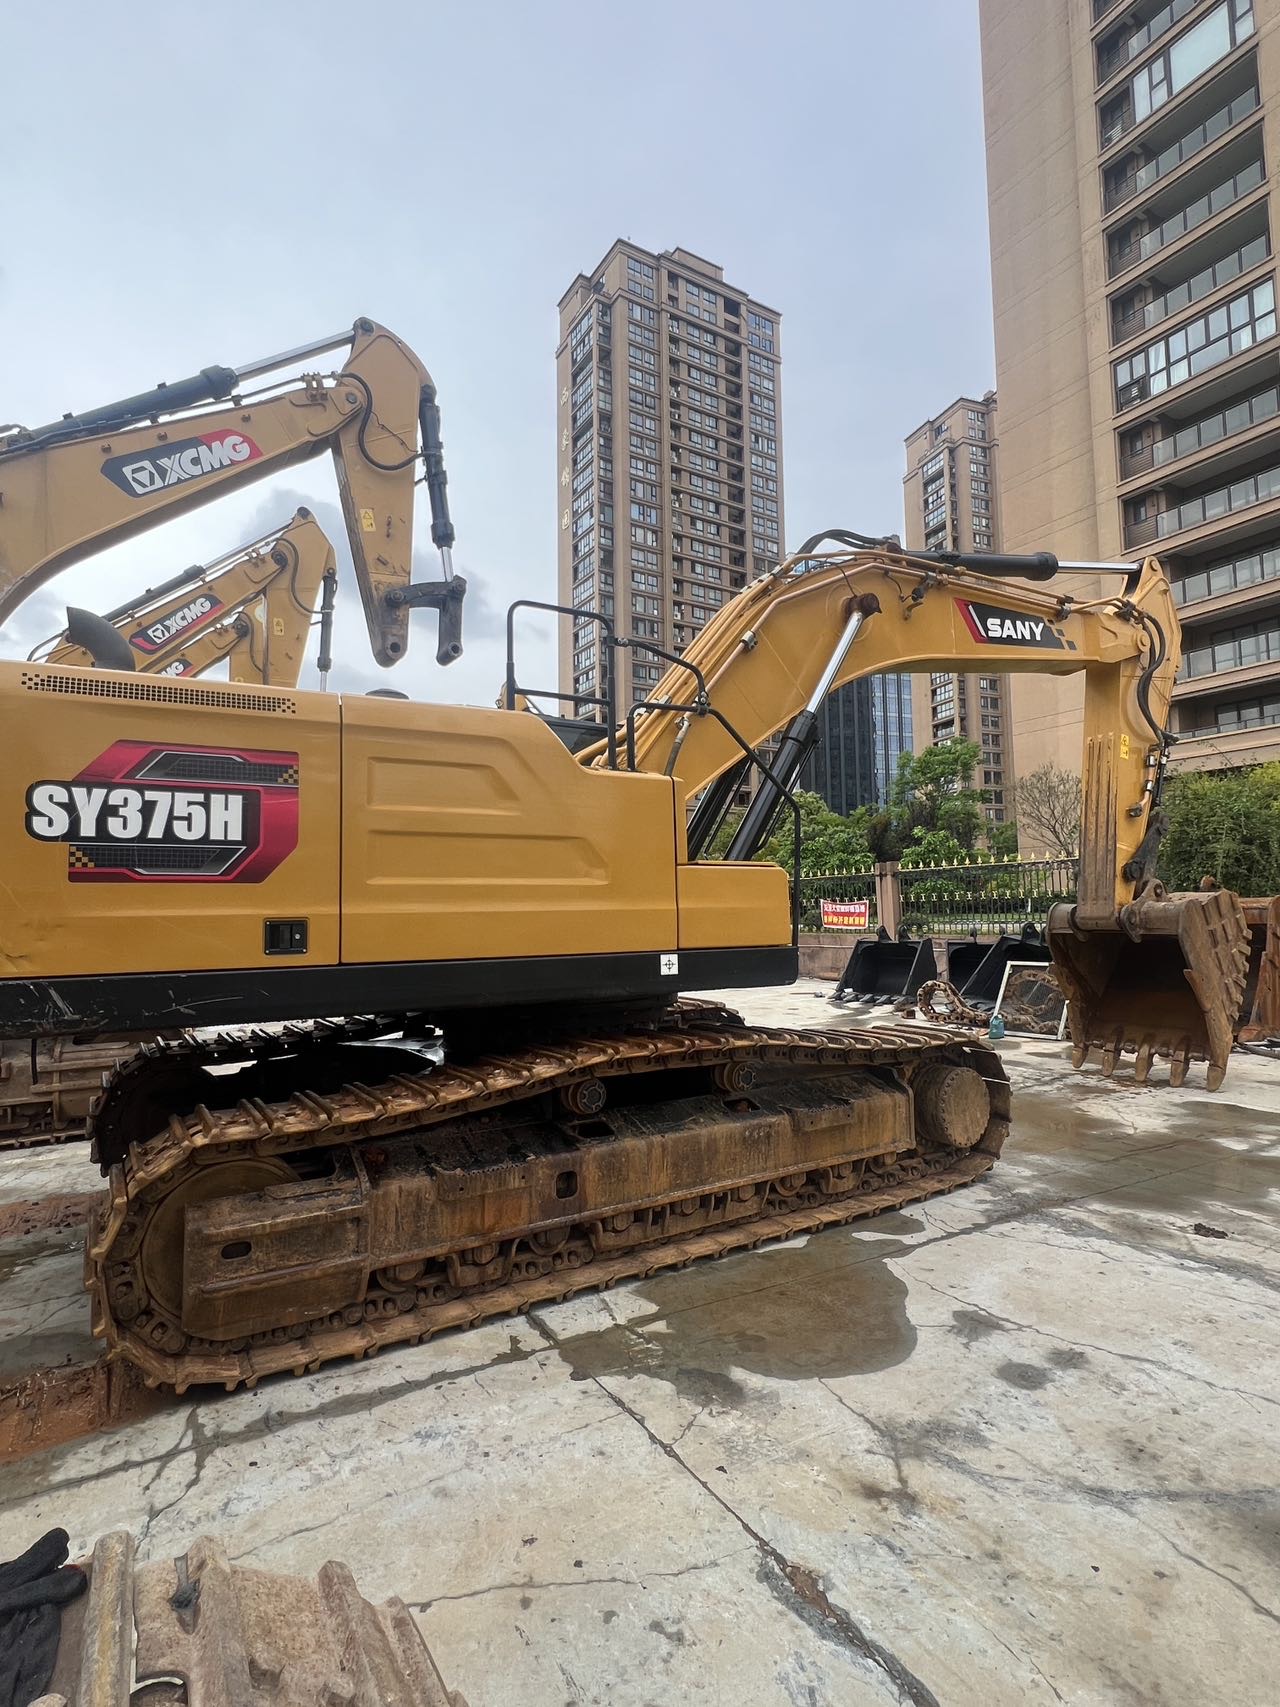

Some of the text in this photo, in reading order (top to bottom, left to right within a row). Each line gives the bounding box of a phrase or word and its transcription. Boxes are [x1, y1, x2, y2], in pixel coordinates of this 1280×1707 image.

[156, 435, 250, 485] XCMG
[163, 597, 212, 635] XCMG
[986, 617, 1045, 641] SANY
[31, 784, 244, 841] SY375H
